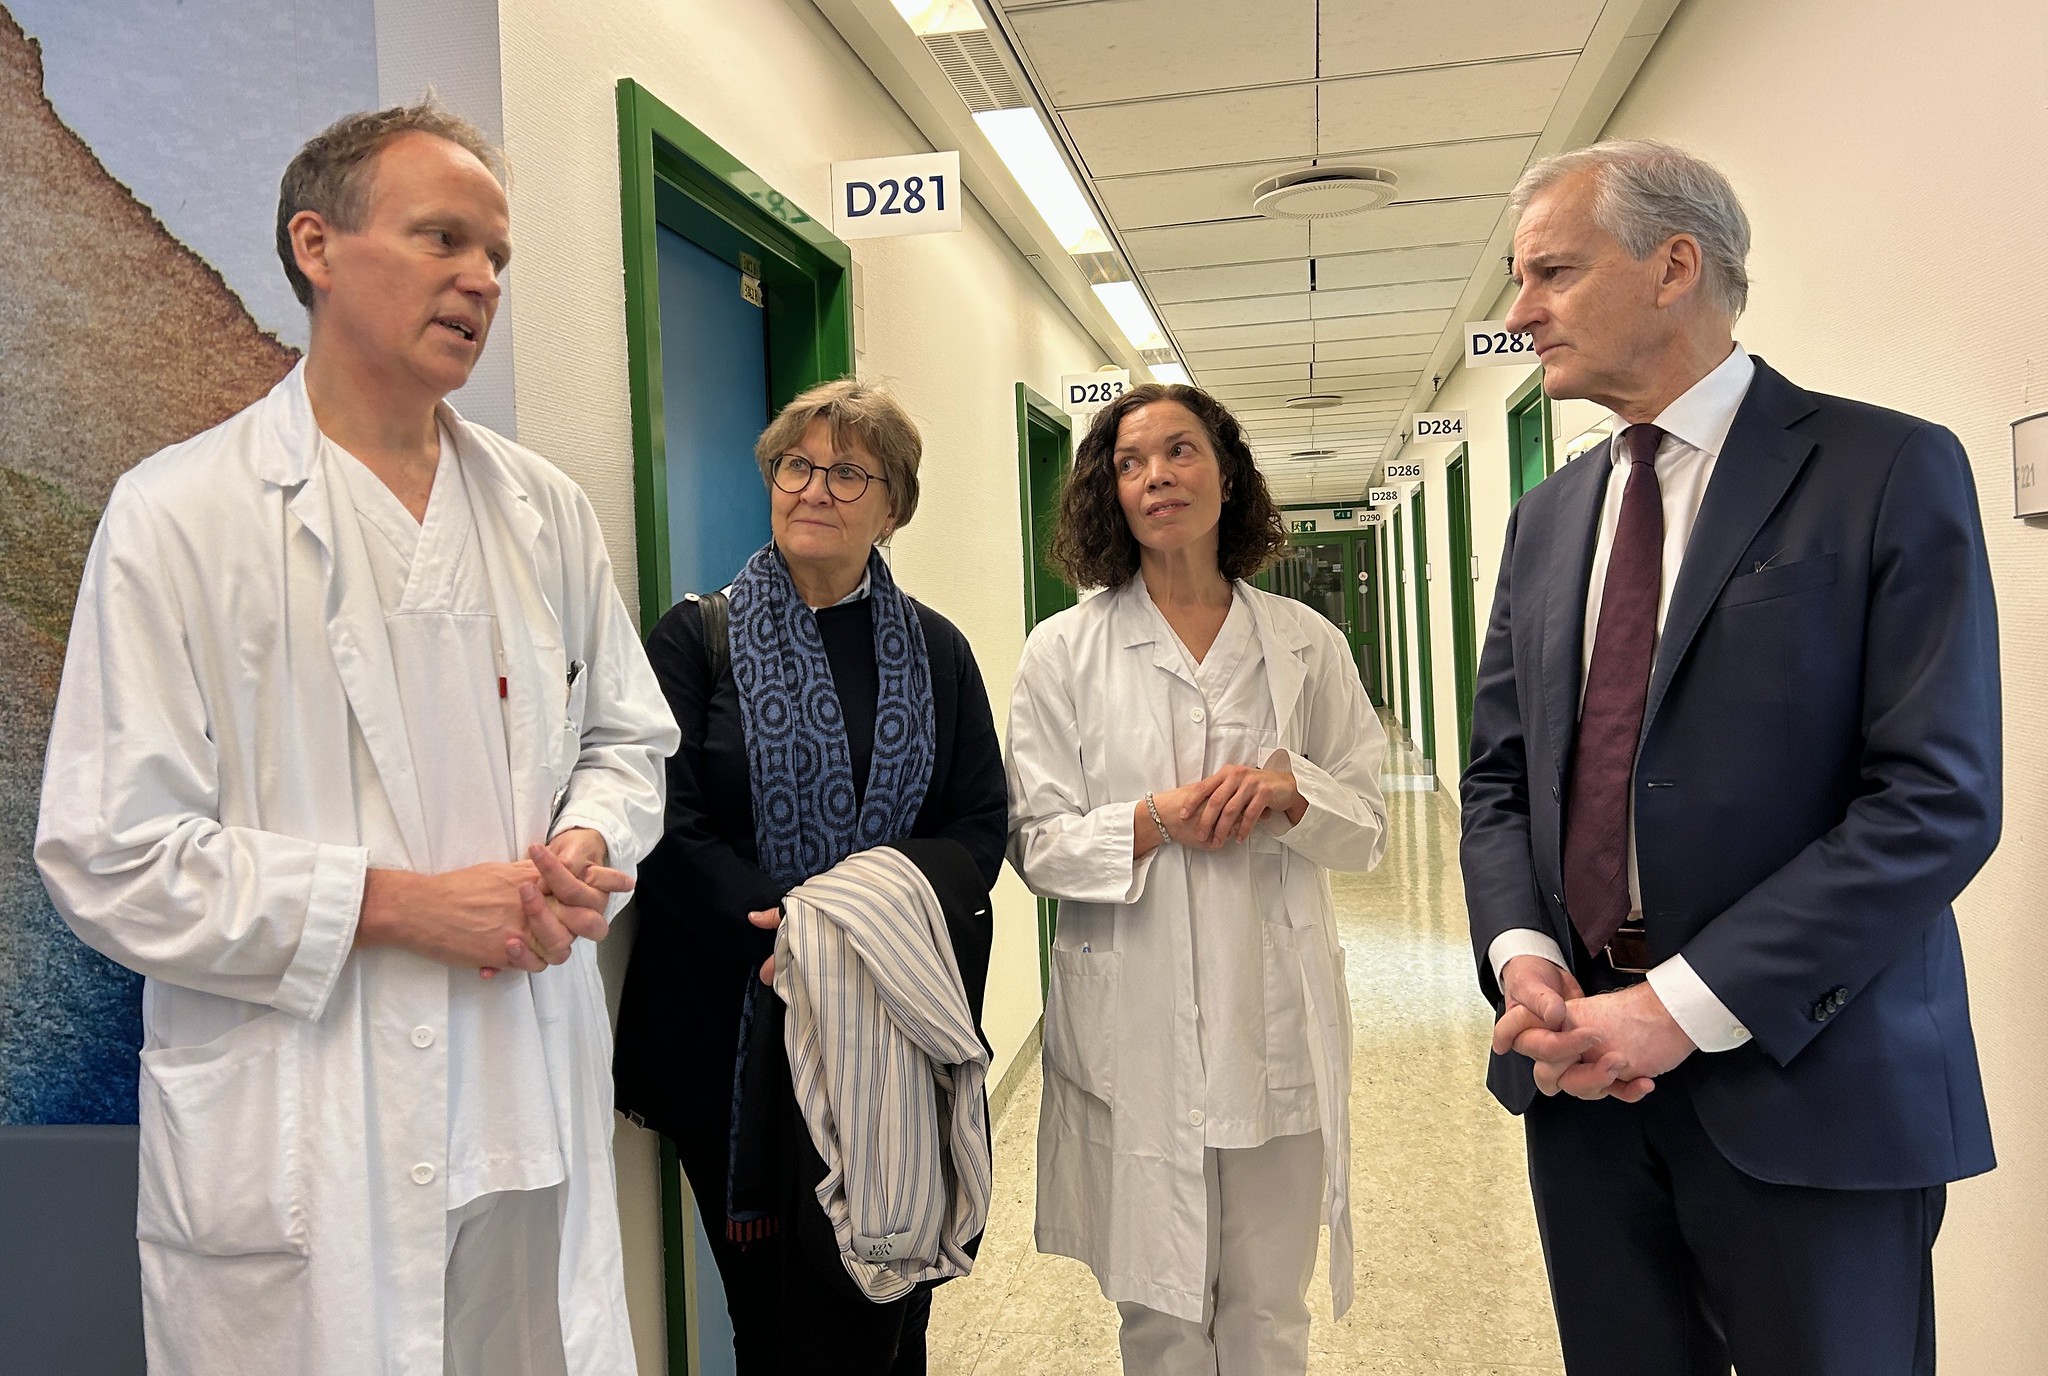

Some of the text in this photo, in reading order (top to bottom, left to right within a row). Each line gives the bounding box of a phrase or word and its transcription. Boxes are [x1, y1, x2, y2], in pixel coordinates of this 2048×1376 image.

[846, 175, 944, 217] D281
[1070, 381, 1124, 404] D283
[1418, 419, 1462, 435] D284
[1387, 464, 1420, 477] D286
[1372, 491, 1398, 502] D288
[1360, 514, 1381, 522] D290
